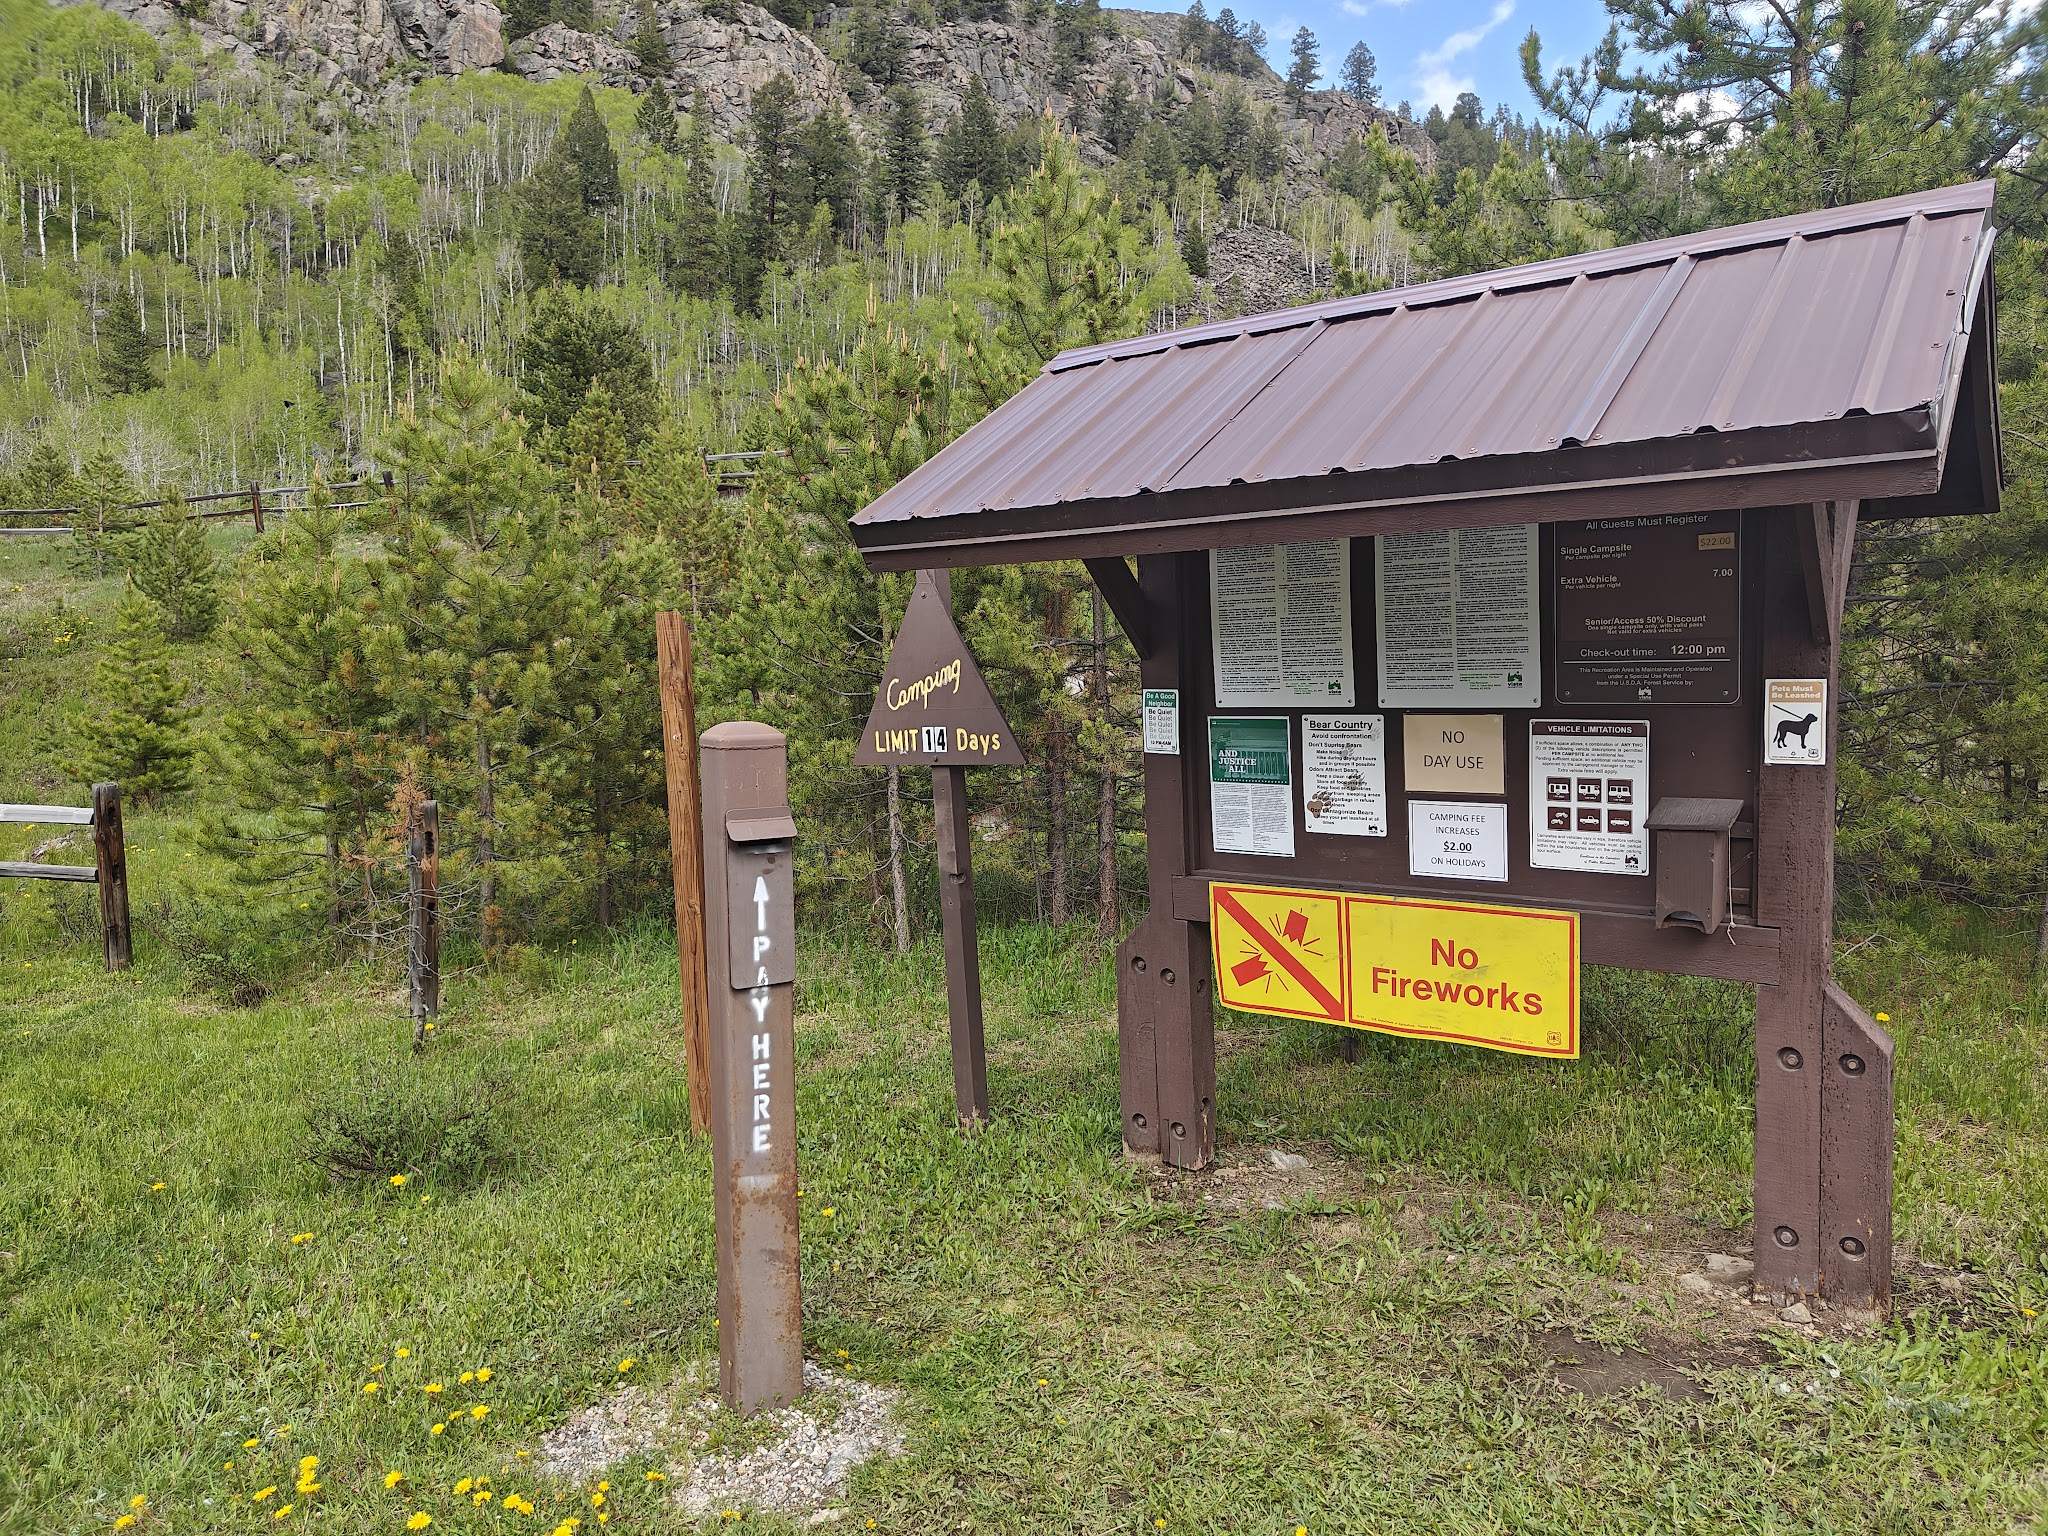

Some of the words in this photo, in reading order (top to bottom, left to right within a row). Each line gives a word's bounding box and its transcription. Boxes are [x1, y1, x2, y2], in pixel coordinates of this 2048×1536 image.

[1586, 521, 1598, 530] All
[1600, 519, 1635, 529] Guests
[1637, 517, 1663, 526] Must
[1665, 514, 1708, 526] Register
[1700, 537, 1731, 547] $22.00
[1560, 546, 1588, 555] Single
[1590, 544, 1632, 553] Campsite
[1713, 568, 1733, 577] 7.00
[1585, 575, 1617, 583] Vehicle
[1585, 617, 1644, 625] Senior/Access
[1580, 648, 1630, 657] Check-out
[1632, 647, 1657, 656] time:
[1670, 644, 1703, 654] 12:00
[1706, 646, 1726, 656] pm
[887, 659, 961, 710] Camping
[1309, 720, 1331, 729] Bear
[1334, 720, 1373, 730] Country
[875, 729, 919, 753] LIMIT
[925, 728, 947, 751] 14
[956, 727, 1001, 756] Days
[1442, 730, 1465, 744] NO
[1424, 755, 1452, 768] DAY
[1456, 756, 1484, 769] USE
[1229, 765, 1246, 773] ALL
[1429, 812, 1469, 822] CAMPING
[1471, 814, 1486, 823] FEE
[1436, 826, 1480, 836] INCREASES
[1443, 841, 1472, 852] $2.00
[1431, 857, 1444, 865] ON
[1446, 857, 1486, 868] HOLIDAYS
[1431, 938, 1479, 970] No
[752, 936, 772, 1022] PAY
[1372, 966, 1543, 1016] Fireworks
[752, 1032, 772, 1153] HERE
